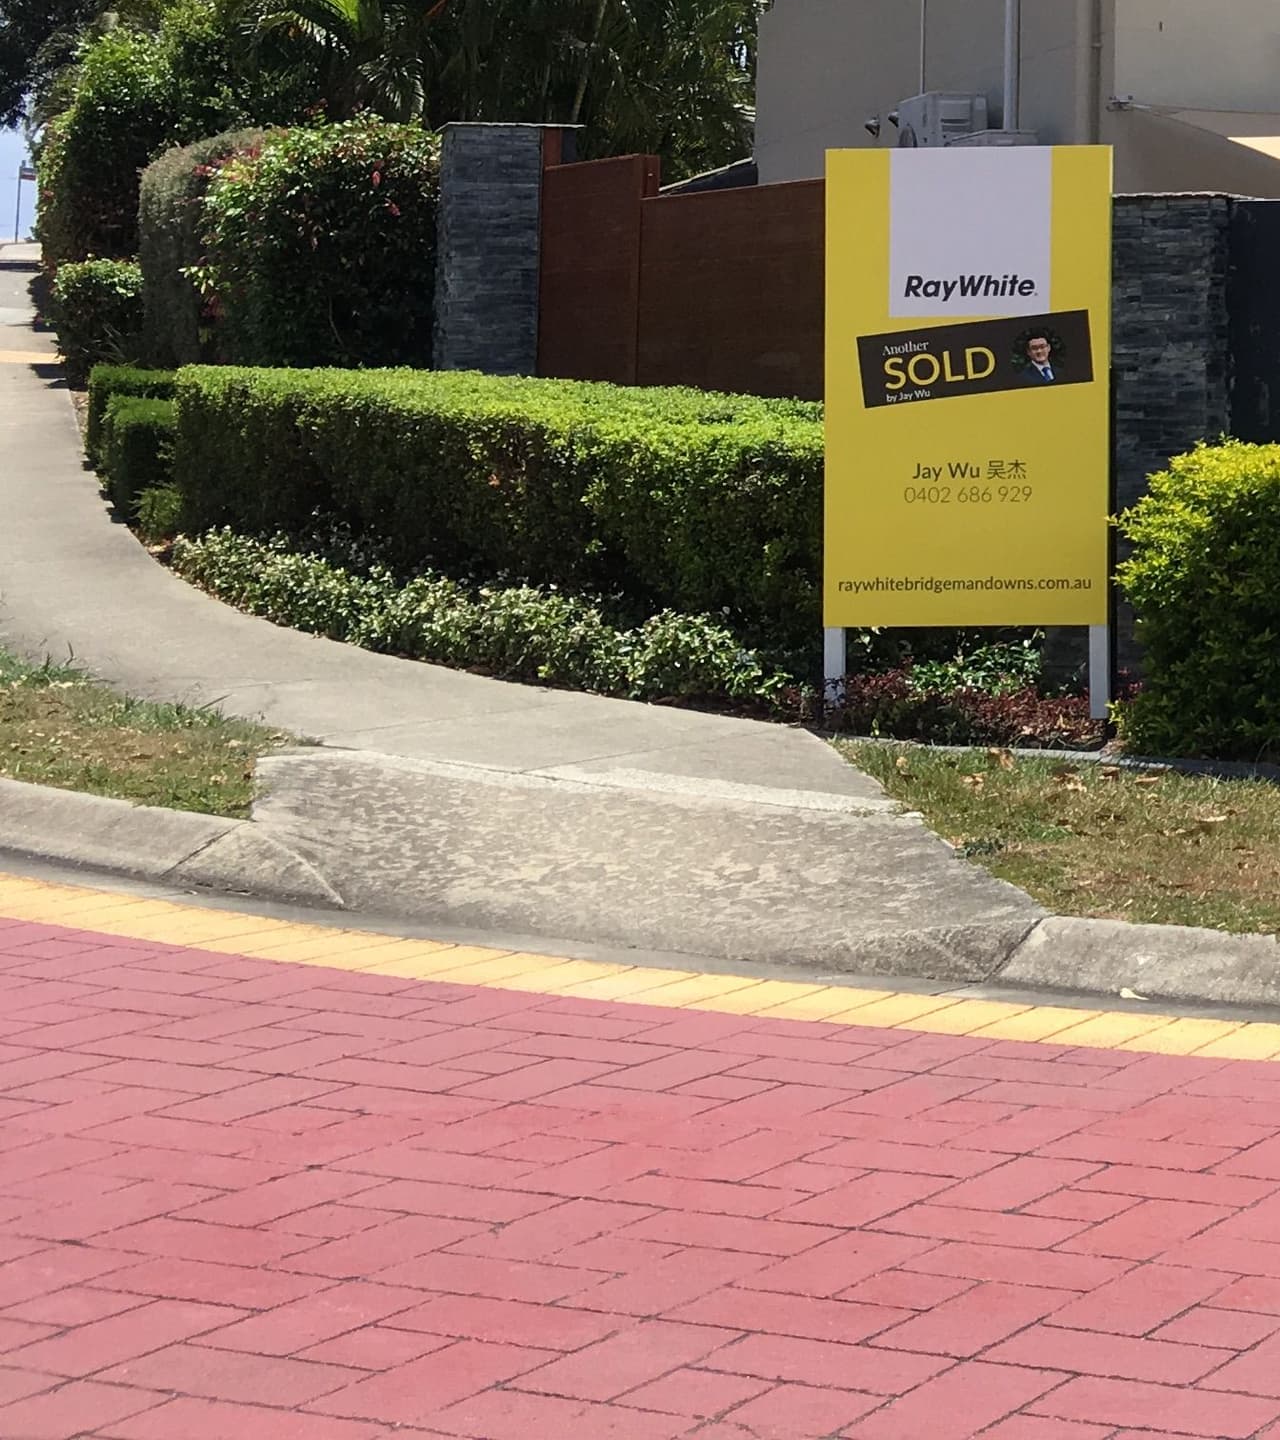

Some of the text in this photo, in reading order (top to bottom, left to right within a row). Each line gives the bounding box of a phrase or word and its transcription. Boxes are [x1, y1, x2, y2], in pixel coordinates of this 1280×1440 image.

[882, 340, 929, 356] Another
[884, 346, 996, 390] SOLD
[886, 389, 931, 403] by Jay Wu
[912, 459, 1027, 482] Jay Wu 吴杰
[904, 485, 1033, 503] 0402 686 929
[838, 576, 1092, 594] raywhitebridgemandowns.com.au
